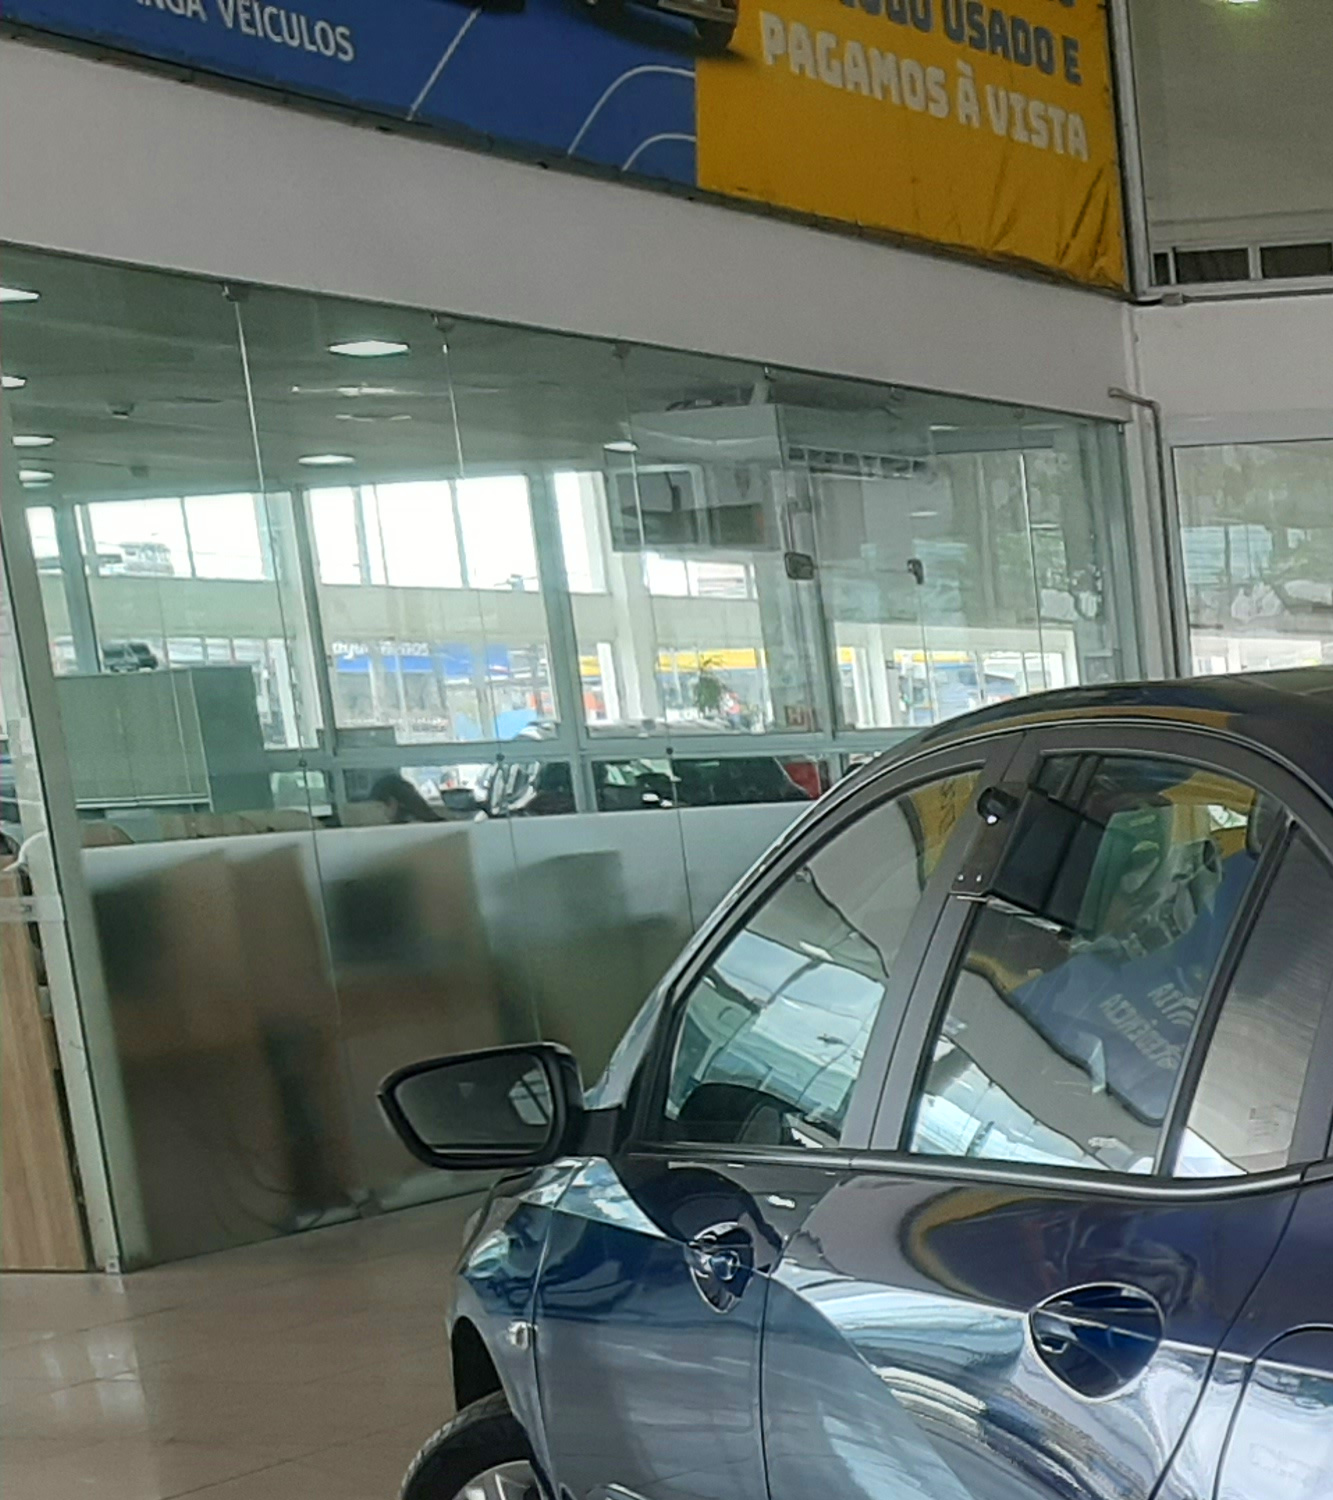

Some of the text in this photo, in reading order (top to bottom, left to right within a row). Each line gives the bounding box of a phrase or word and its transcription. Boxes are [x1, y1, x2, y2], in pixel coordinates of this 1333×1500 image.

[760, 10, 950, 119] PAGAMOS
[957, 58, 980, 129] À
[986, 84, 1089, 163] VISTA
[943, 0, 1056, 76] USADO
[1063, 35, 1082, 86] E
